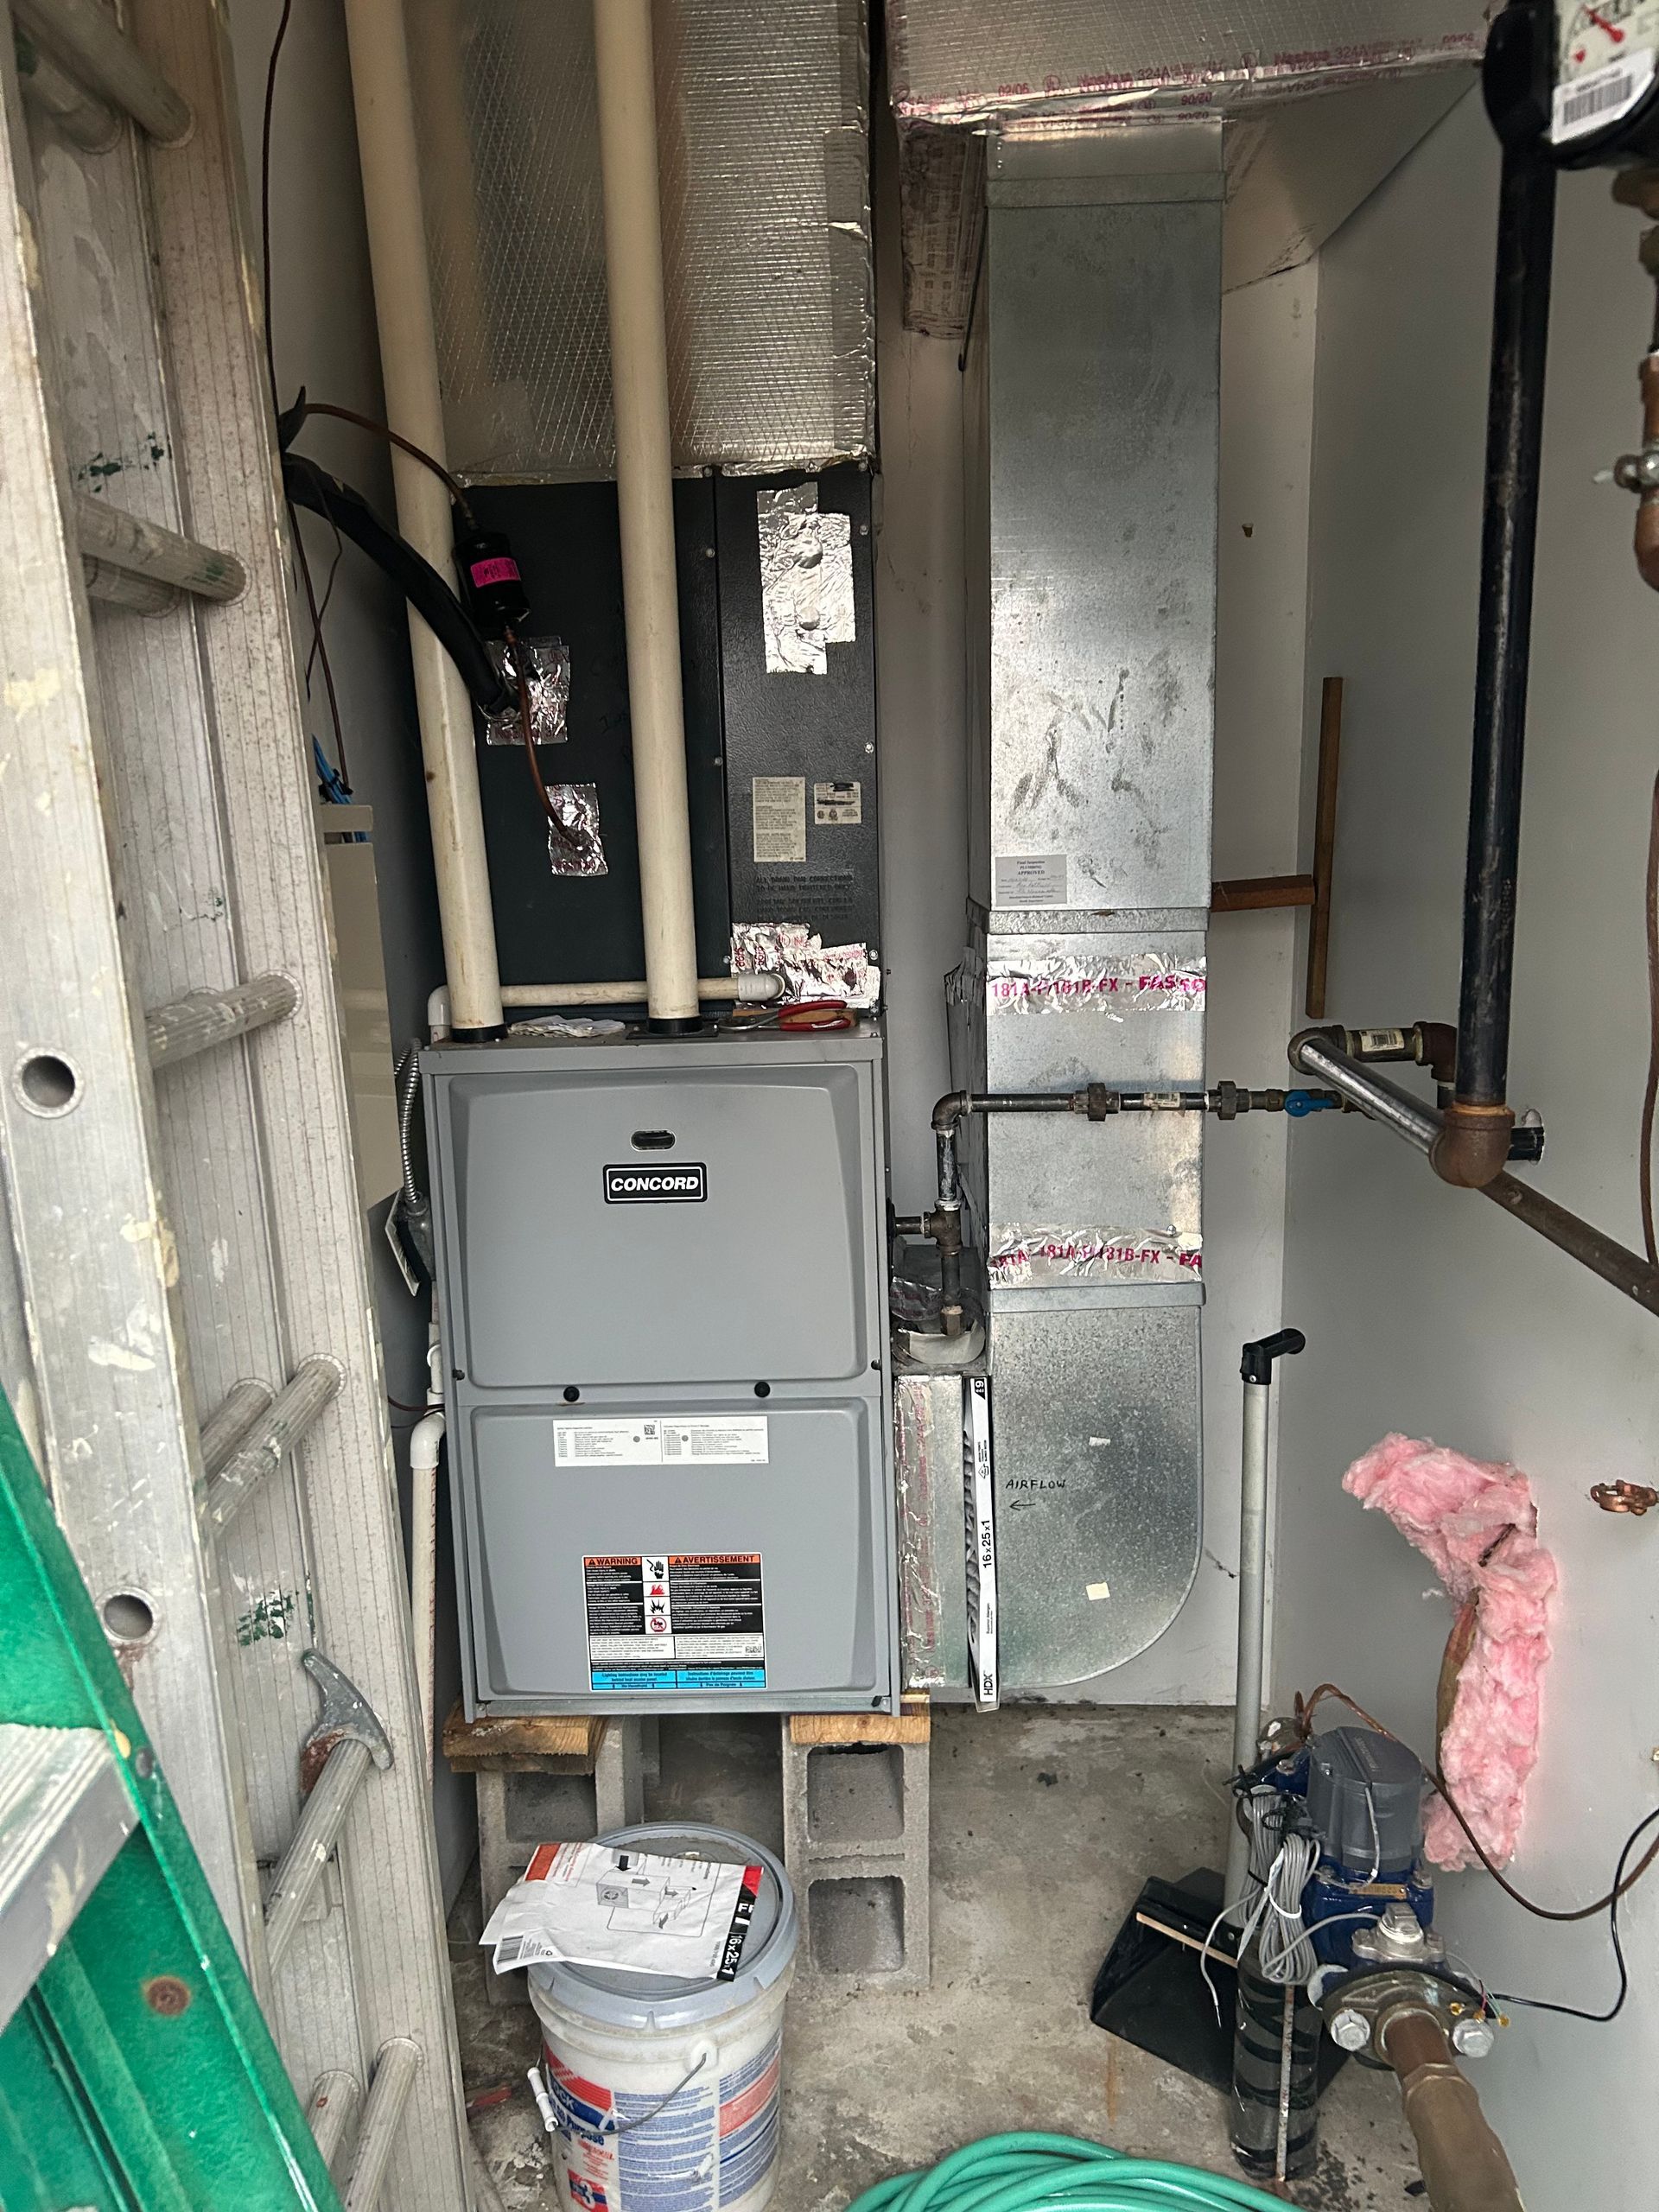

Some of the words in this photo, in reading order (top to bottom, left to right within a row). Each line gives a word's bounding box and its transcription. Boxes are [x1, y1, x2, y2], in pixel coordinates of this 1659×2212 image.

[610, 1176, 699, 1192] CONCORD
[975, 1380, 984, 1389] 9
[1005, 1478, 1066, 1491] AIRFLOW
[983, 1674, 994, 1696] HDX
